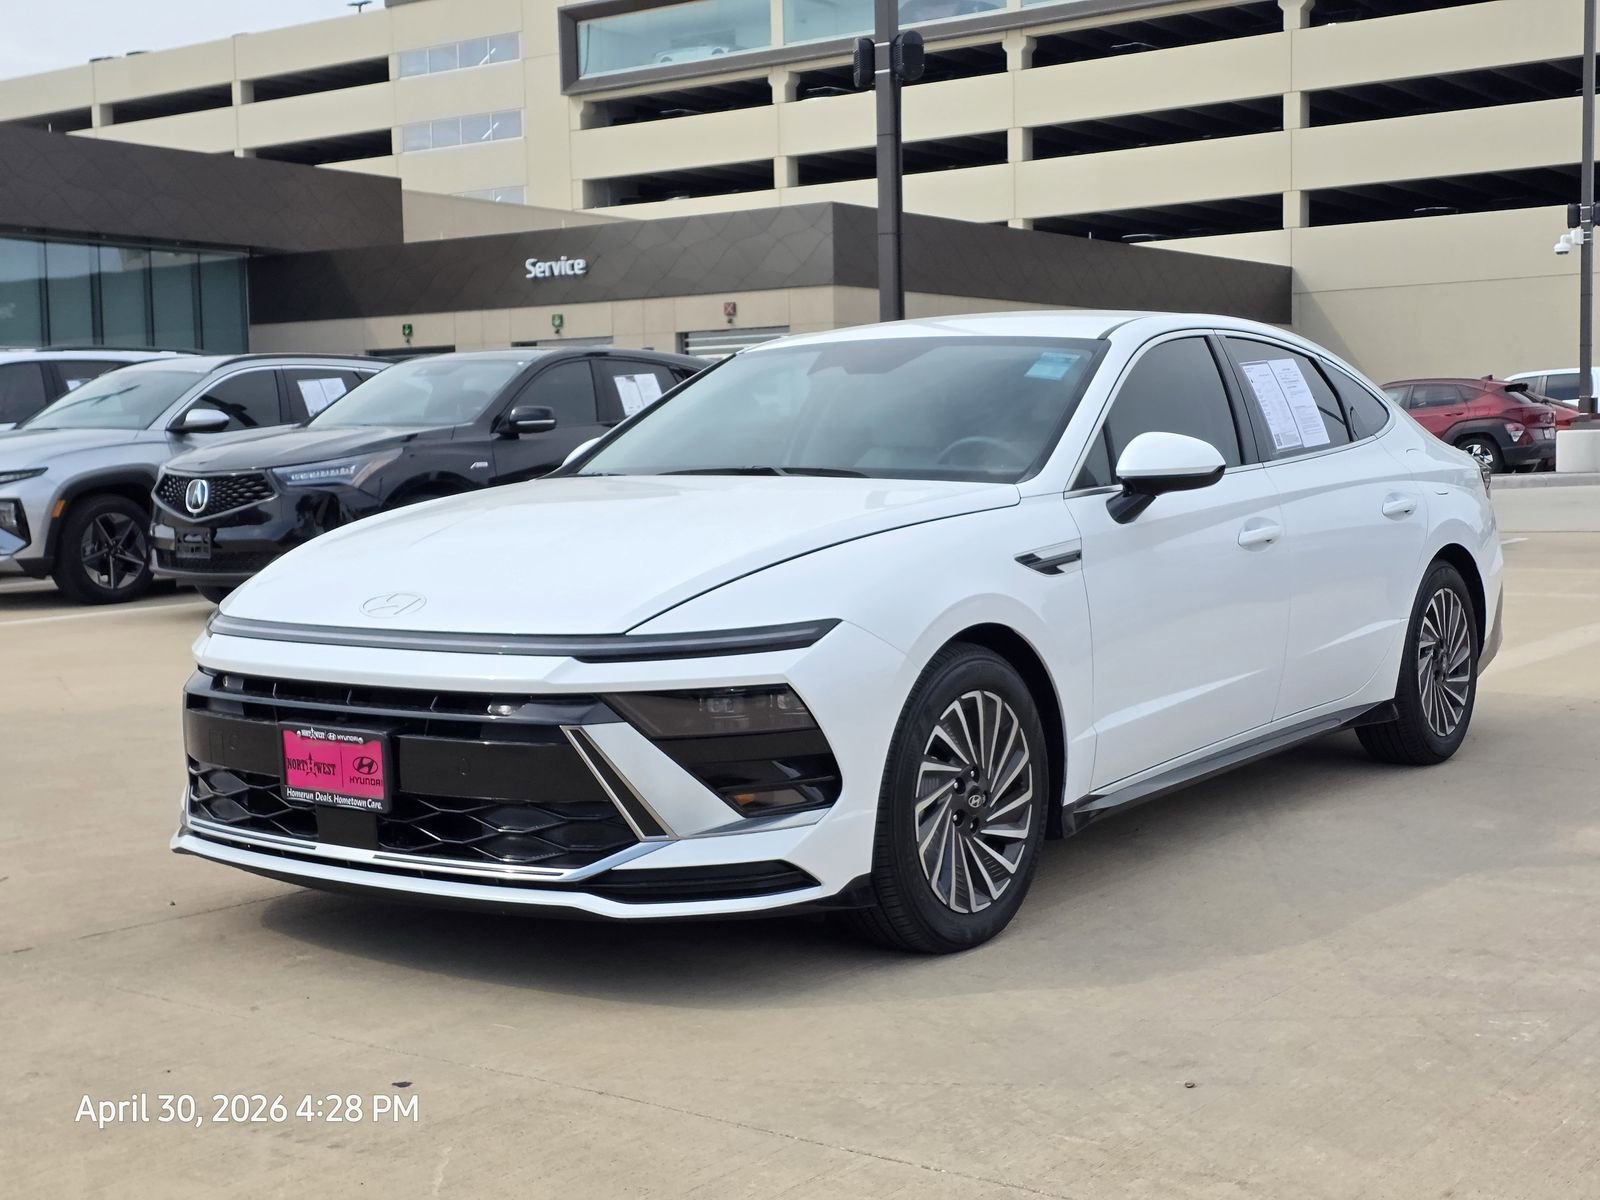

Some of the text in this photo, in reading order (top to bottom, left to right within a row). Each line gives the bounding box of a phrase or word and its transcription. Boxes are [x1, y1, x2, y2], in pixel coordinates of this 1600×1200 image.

[525, 255, 587, 279] Service
[287, 788, 383, 810] Homerun Deals. Hometown Care.
